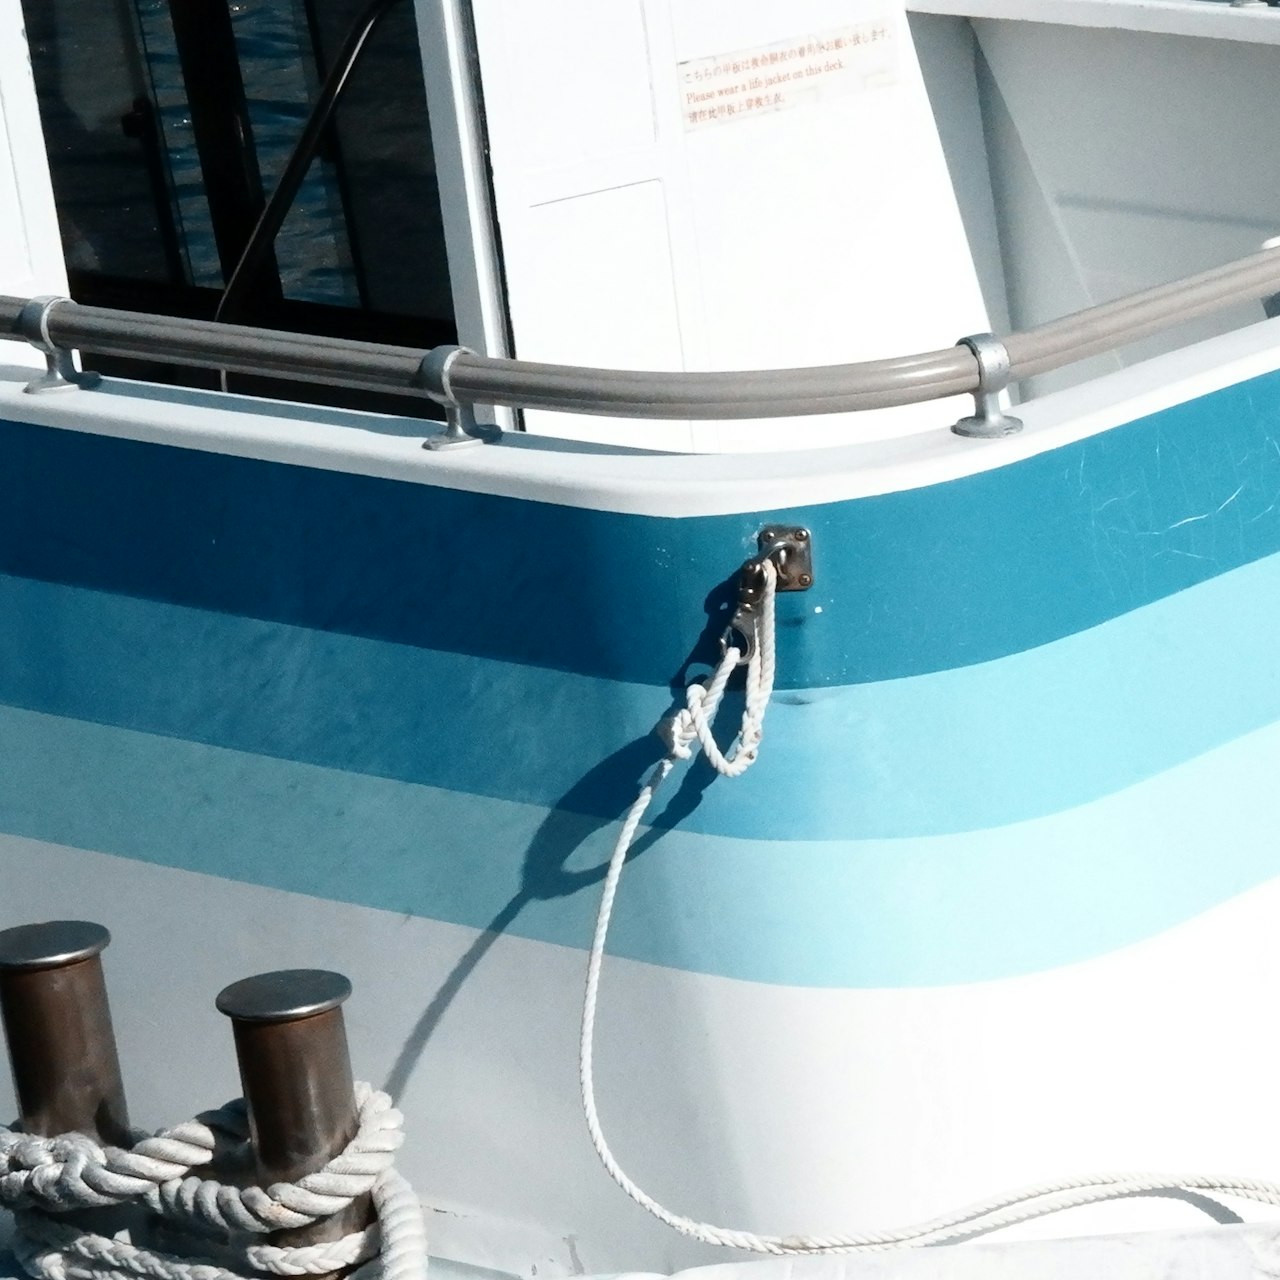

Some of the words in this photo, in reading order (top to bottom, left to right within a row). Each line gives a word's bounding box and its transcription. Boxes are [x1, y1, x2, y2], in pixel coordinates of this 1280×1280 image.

[686, 89, 715, 104] Please
[717, 84, 739, 97] wear
[749, 77, 763, 90] life
[764, 72, 790, 88] jacket
[792, 69, 803, 79] on
[805, 64, 822, 77] this
